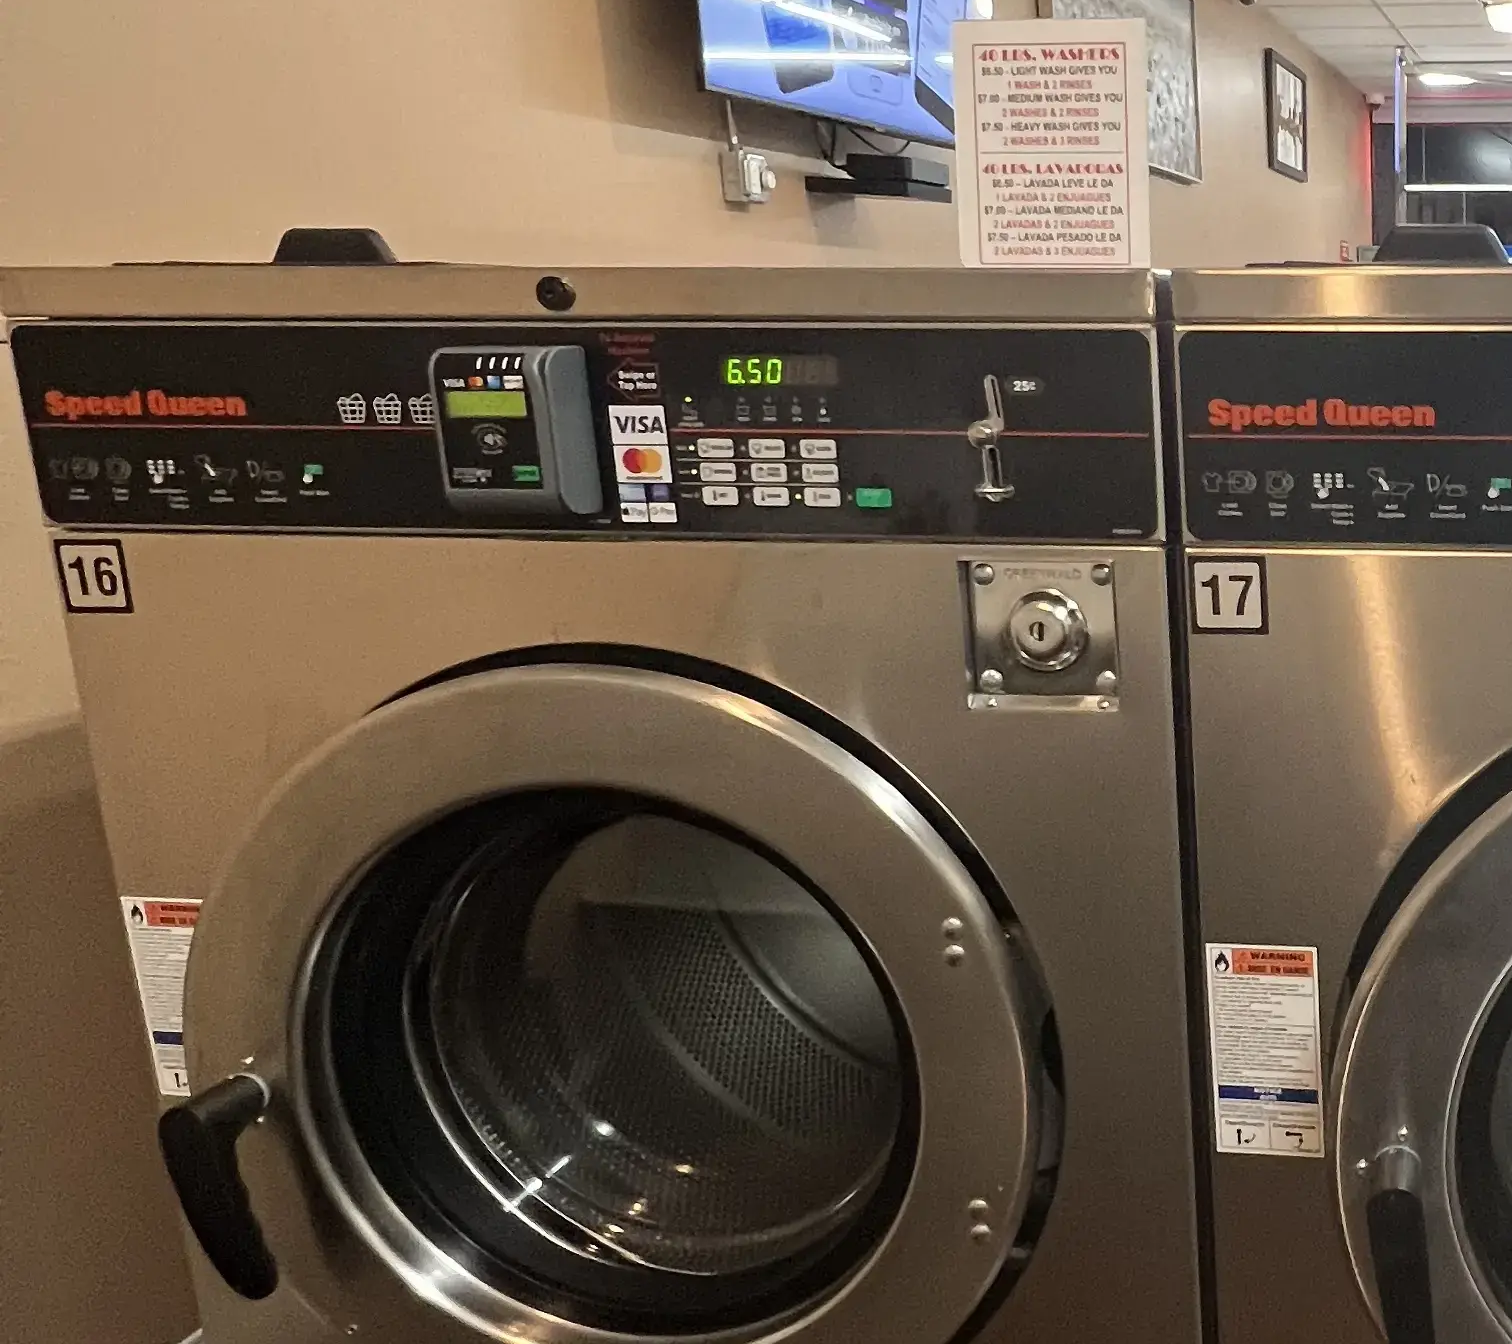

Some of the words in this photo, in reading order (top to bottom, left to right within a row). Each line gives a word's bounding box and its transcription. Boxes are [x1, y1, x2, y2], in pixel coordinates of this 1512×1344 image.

[978, 49, 999, 61] 40
[1040, 47, 1120, 60] WASHERS
[1010, 66, 1037, 76] LIGHT
[1040, 66, 1067, 75] WASH
[1069, 66, 1096, 75] GIVES
[1099, 65, 1118, 75] YOU
[1014, 80, 1042, 89] WASH
[1059, 80, 1093, 89] RINSES
[1007, 94, 1043, 103] MEDIUM
[1045, 94, 1072, 103] WASH
[1074, 93, 1101, 102] GIVES
[1104, 93, 1124, 102] YOU
[1009, 108, 1048, 117] WASHES
[1066, 108, 1100, 117] RINSES
[1010, 122, 1042, 131] HEAVY
[1043, 122, 1070, 131] WASH
[1072, 122, 1099, 131] GIVES
[1102, 121, 1121, 131] YOU
[1010, 136, 1049, 145] WASHES
[1067, 136, 1100, 145] RINSES
[982, 164, 999, 174] 40
[1023, 179, 1060, 188] LAVADA
[1062, 179, 1085, 188] LEVE
[1087, 179, 1097, 188] LE
[1101, 178, 1114, 188] DA
[1002, 193, 1039, 202] LAVADA
[1057, 192, 1111, 202] ENJUAGUES
[1015, 206, 1051, 215] LAVADA
[1097, 206, 1108, 215] LE
[1110, 206, 1124, 215] DA
[1001, 220, 1042, 229] LAVADAS
[1060, 220, 1115, 229] ENJUAGUES
[1018, 233, 1054, 242] LAVADA
[1057, 233, 1093, 242] PESADO
[1095, 233, 1107, 242] LE
[1109, 232, 1122, 242] DA
[1002, 247, 1043, 256] LAVADAS
[1061, 247, 1116, 256] ENJUAGUES
[726, 358, 784, 385] 6.50
[44, 390, 142, 421] Speed
[146, 389, 248, 416] Queen
[1207, 398, 1318, 432] Speed
[1323, 398, 1436, 428] Queen
[613, 415, 665, 435] VISA
[68, 555, 118, 596] 16
[1201, 574, 1254, 616] 17
[1250, 951, 1306, 962] WARNING
